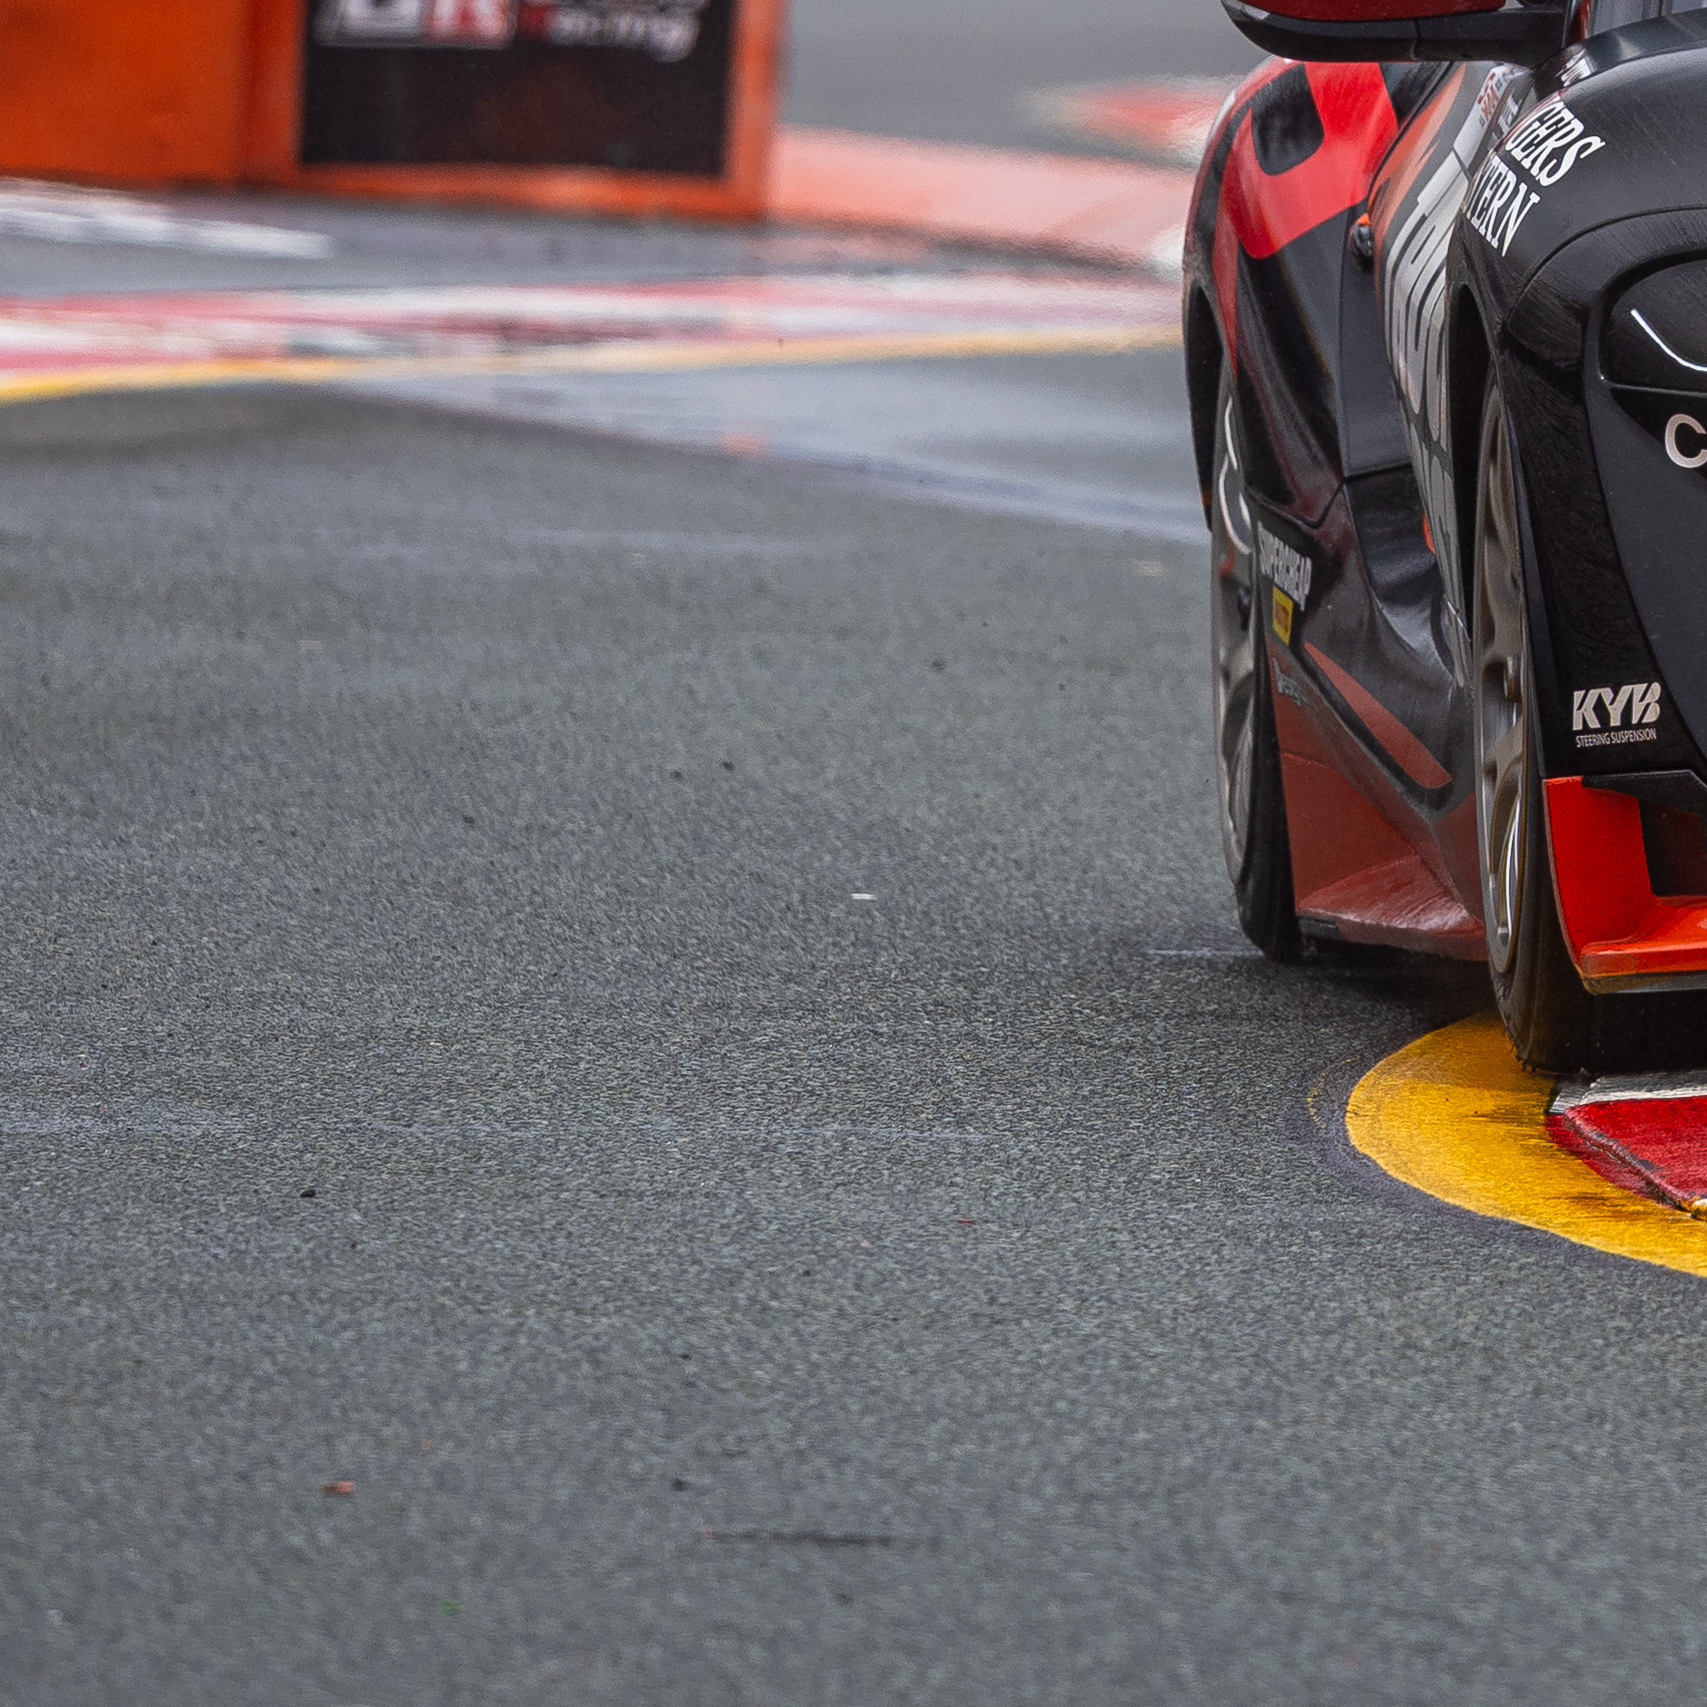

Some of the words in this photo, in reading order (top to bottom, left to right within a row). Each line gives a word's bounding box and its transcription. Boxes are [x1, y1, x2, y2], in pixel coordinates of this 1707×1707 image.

[1505, 96, 1607, 187] GERS
[1572, 681, 1662, 731] KYB
[1576, 732, 1611, 748] STEERING
[1611, 727, 1657, 744] SUSPENSION
